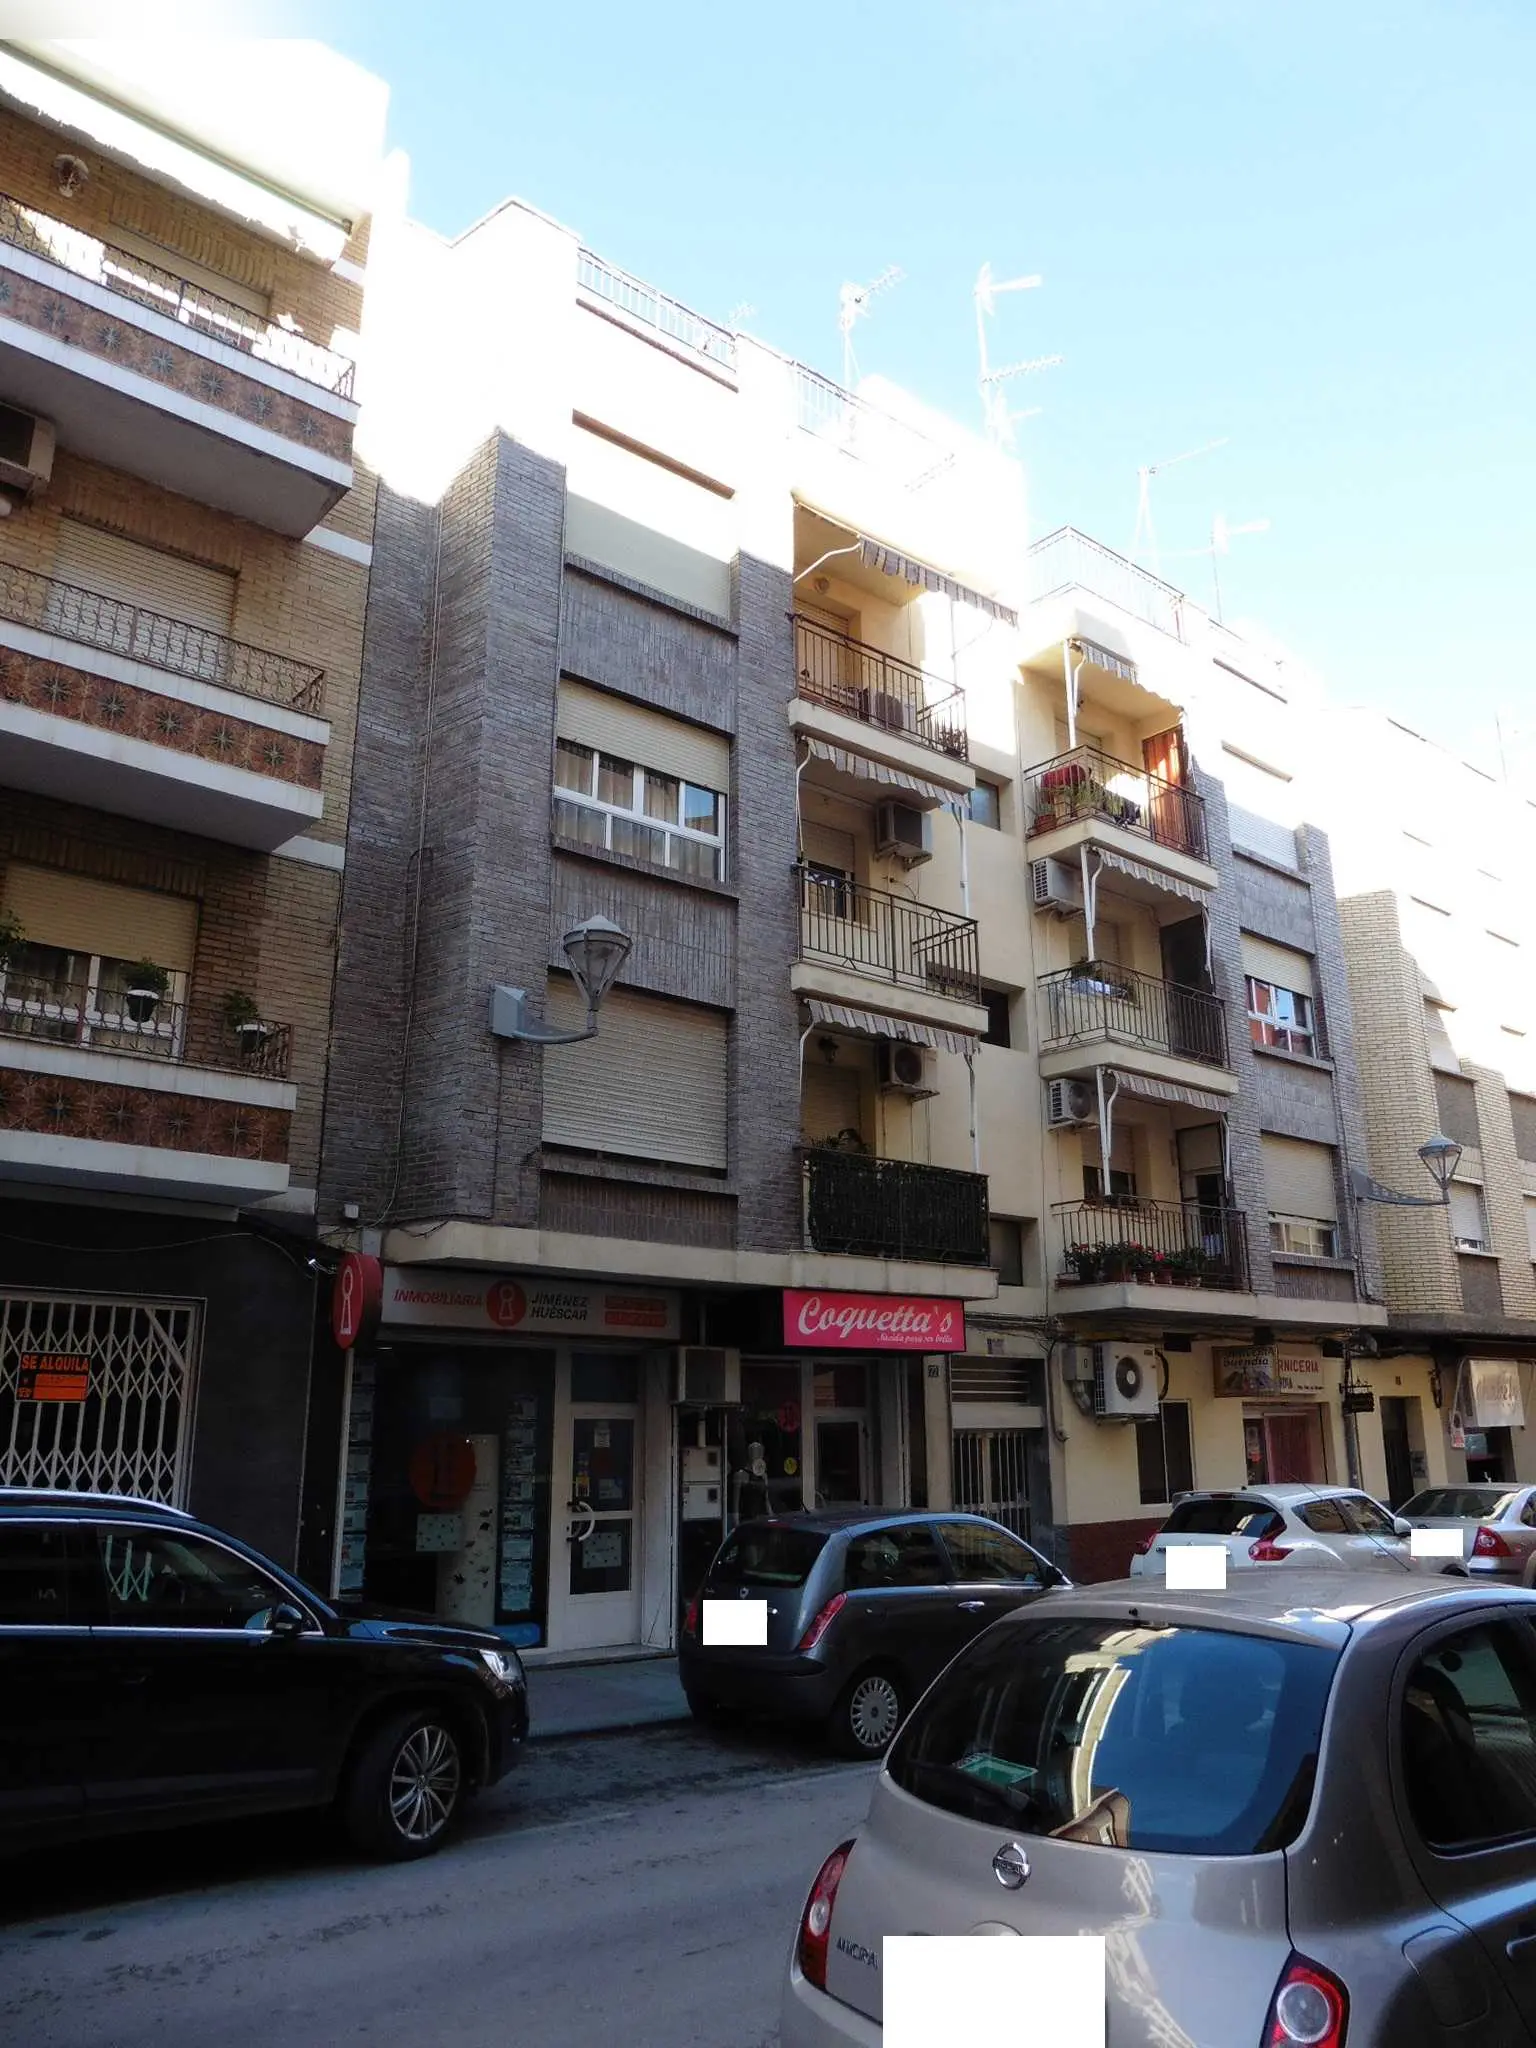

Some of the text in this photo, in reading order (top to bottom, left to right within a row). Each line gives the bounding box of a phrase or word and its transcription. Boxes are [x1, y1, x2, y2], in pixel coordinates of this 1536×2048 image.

[393, 1289, 483, 1306] INMOBILIARIA
[21, 1354, 89, 1372] SE ALQUILA
